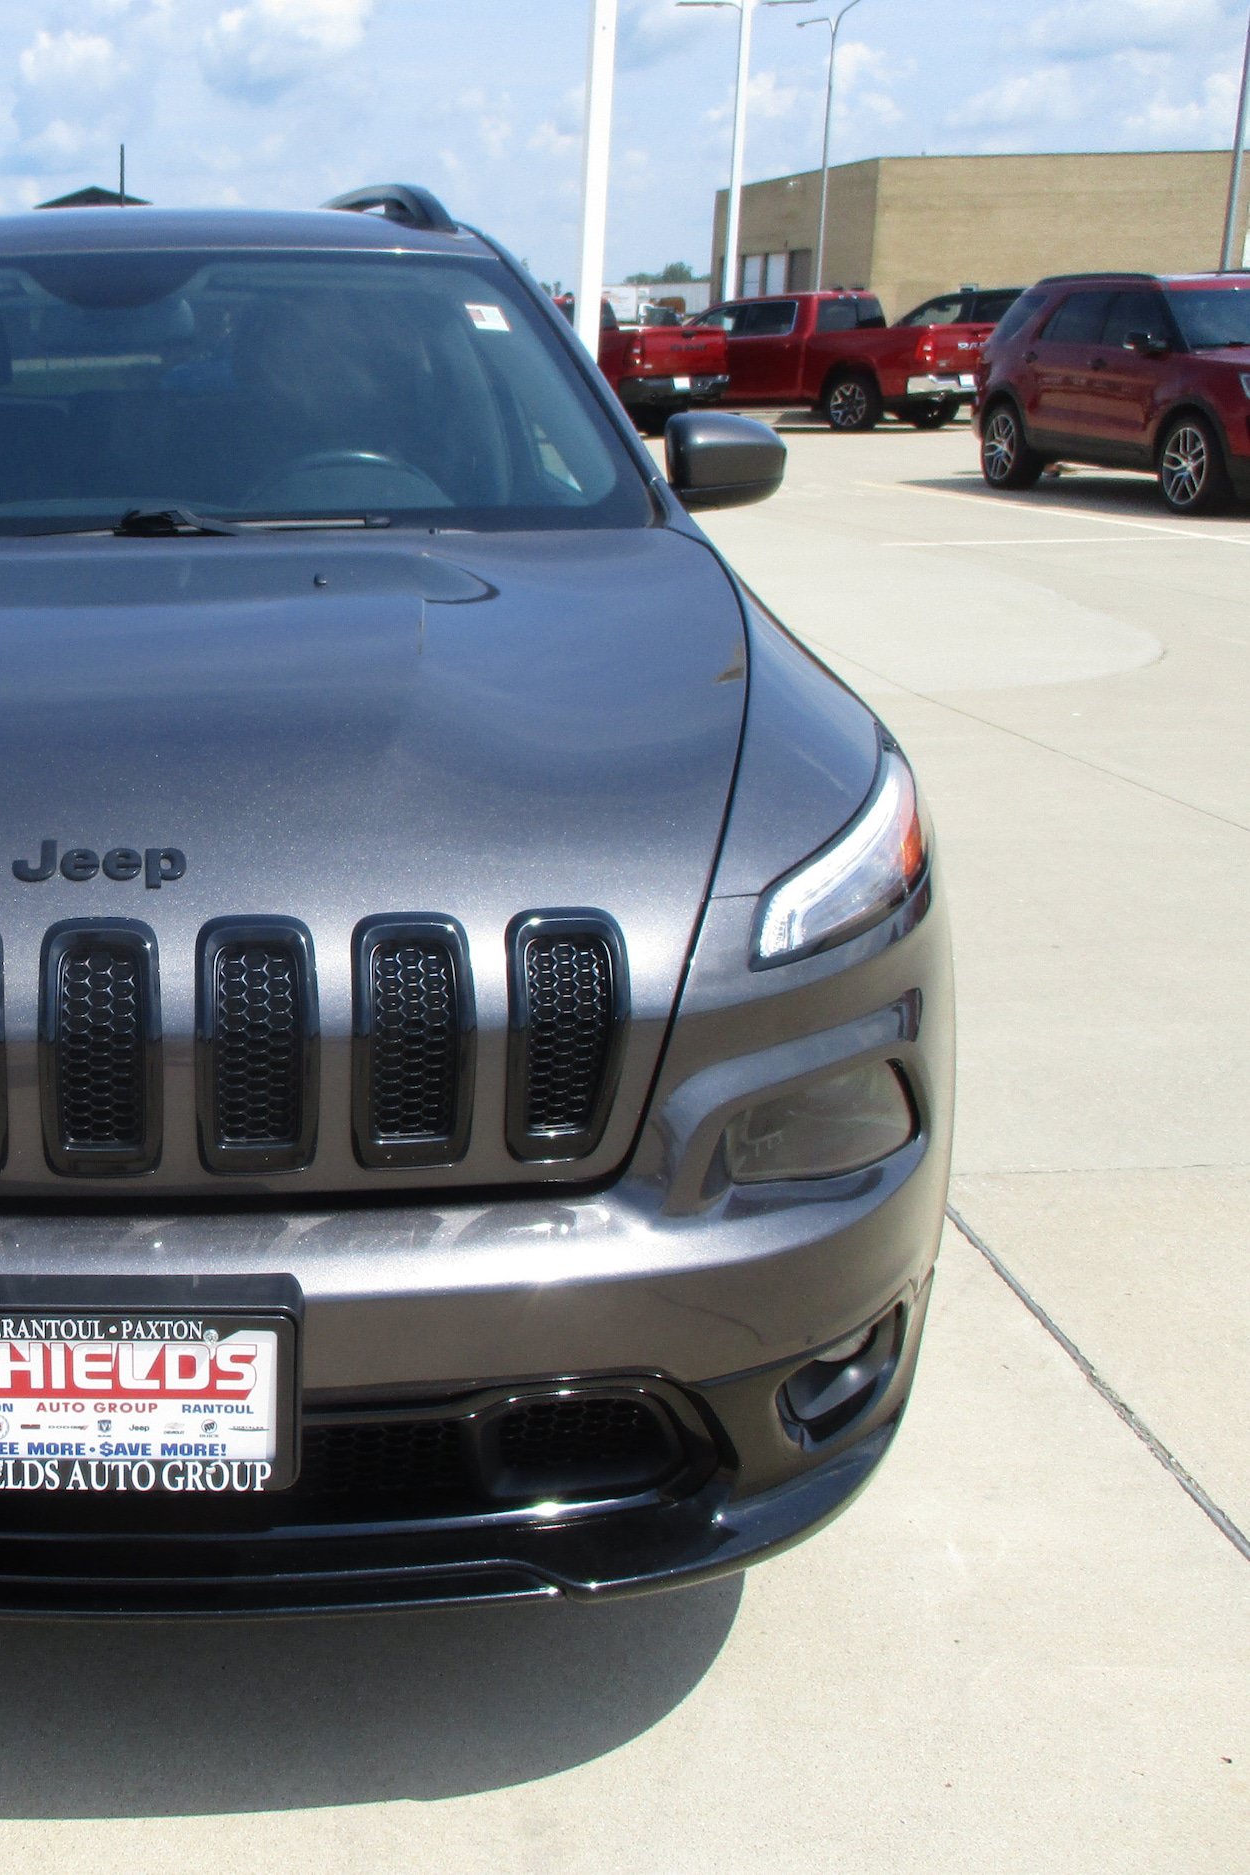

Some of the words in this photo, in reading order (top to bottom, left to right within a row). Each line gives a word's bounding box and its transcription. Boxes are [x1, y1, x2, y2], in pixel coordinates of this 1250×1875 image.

[12, 839, 187, 889] Jeep
[1, 1318, 105, 1340] RANTOUL
[121, 1319, 203, 1340] PAXTON
[36, 1402, 85, 1413] AUTO
[93, 1402, 158, 1414] GROUP
[181, 1404, 254, 1415] RANTOUL
[128, 1424, 150, 1432] Jeep
[27, 1442, 86, 1456] MORE
[99, 1441, 152, 1457] $AVE
[160, 1443, 227, 1457] MORE!
[66, 1459, 155, 1491] AUTO
[162, 1459, 272, 1492] GROUP
